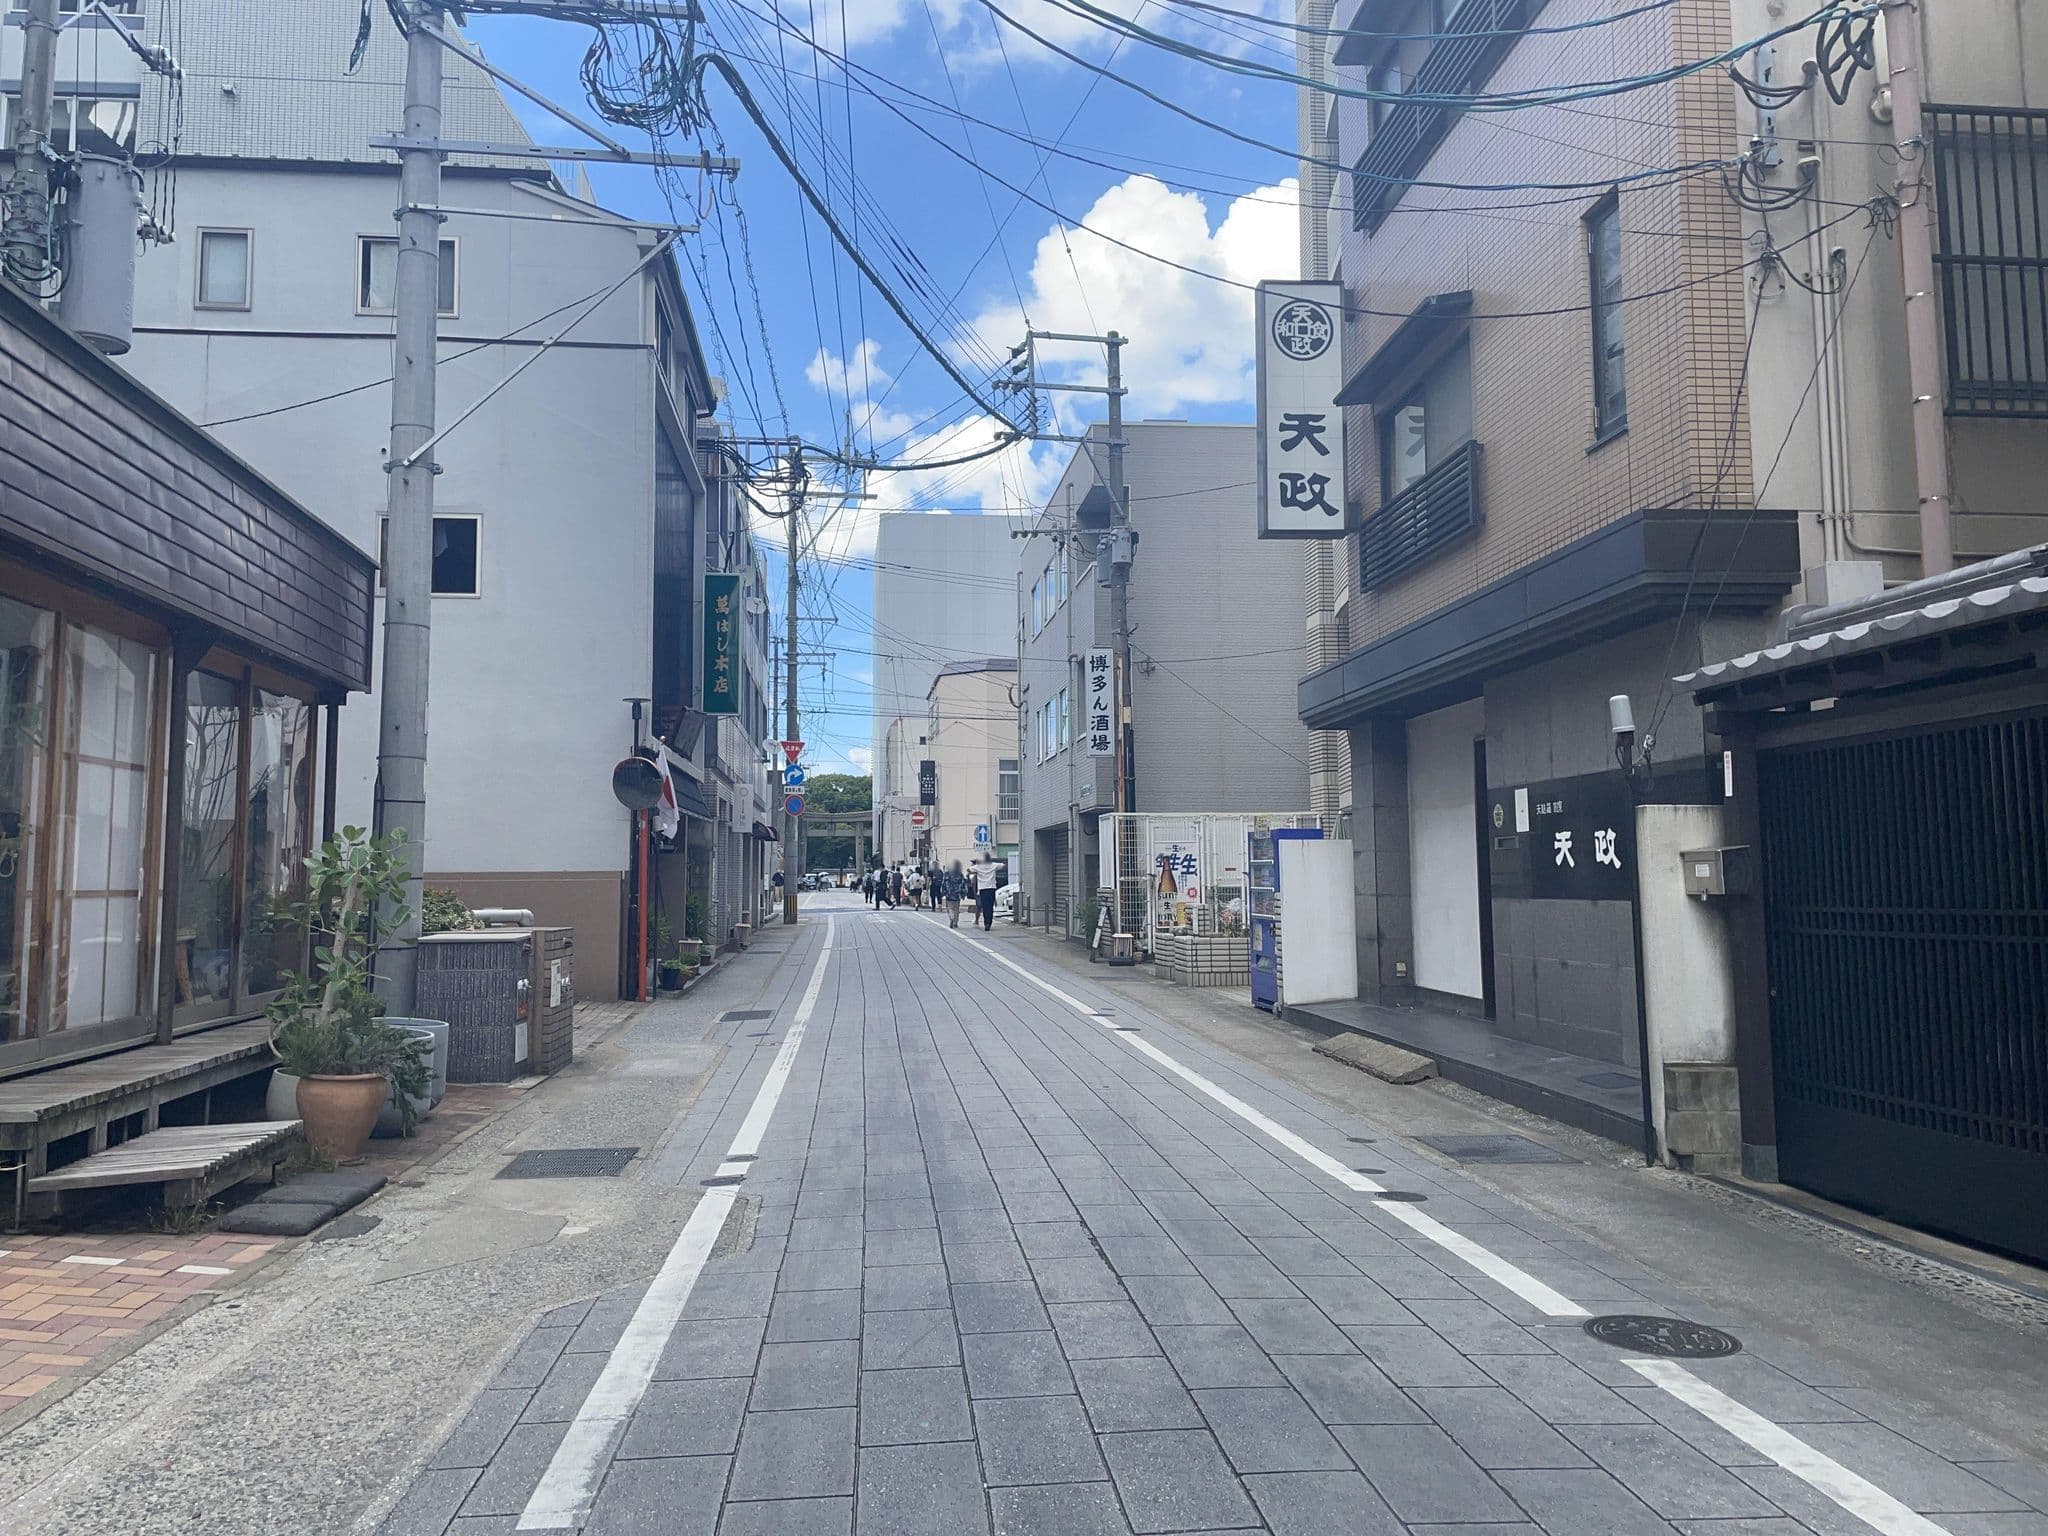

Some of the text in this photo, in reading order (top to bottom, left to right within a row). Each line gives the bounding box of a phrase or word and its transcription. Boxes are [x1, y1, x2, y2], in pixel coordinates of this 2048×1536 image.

[1279, 412, 1339, 517] 天政
[1089, 655, 1111, 752] 博多ん酒場
[1554, 827, 1622, 869] 天政
